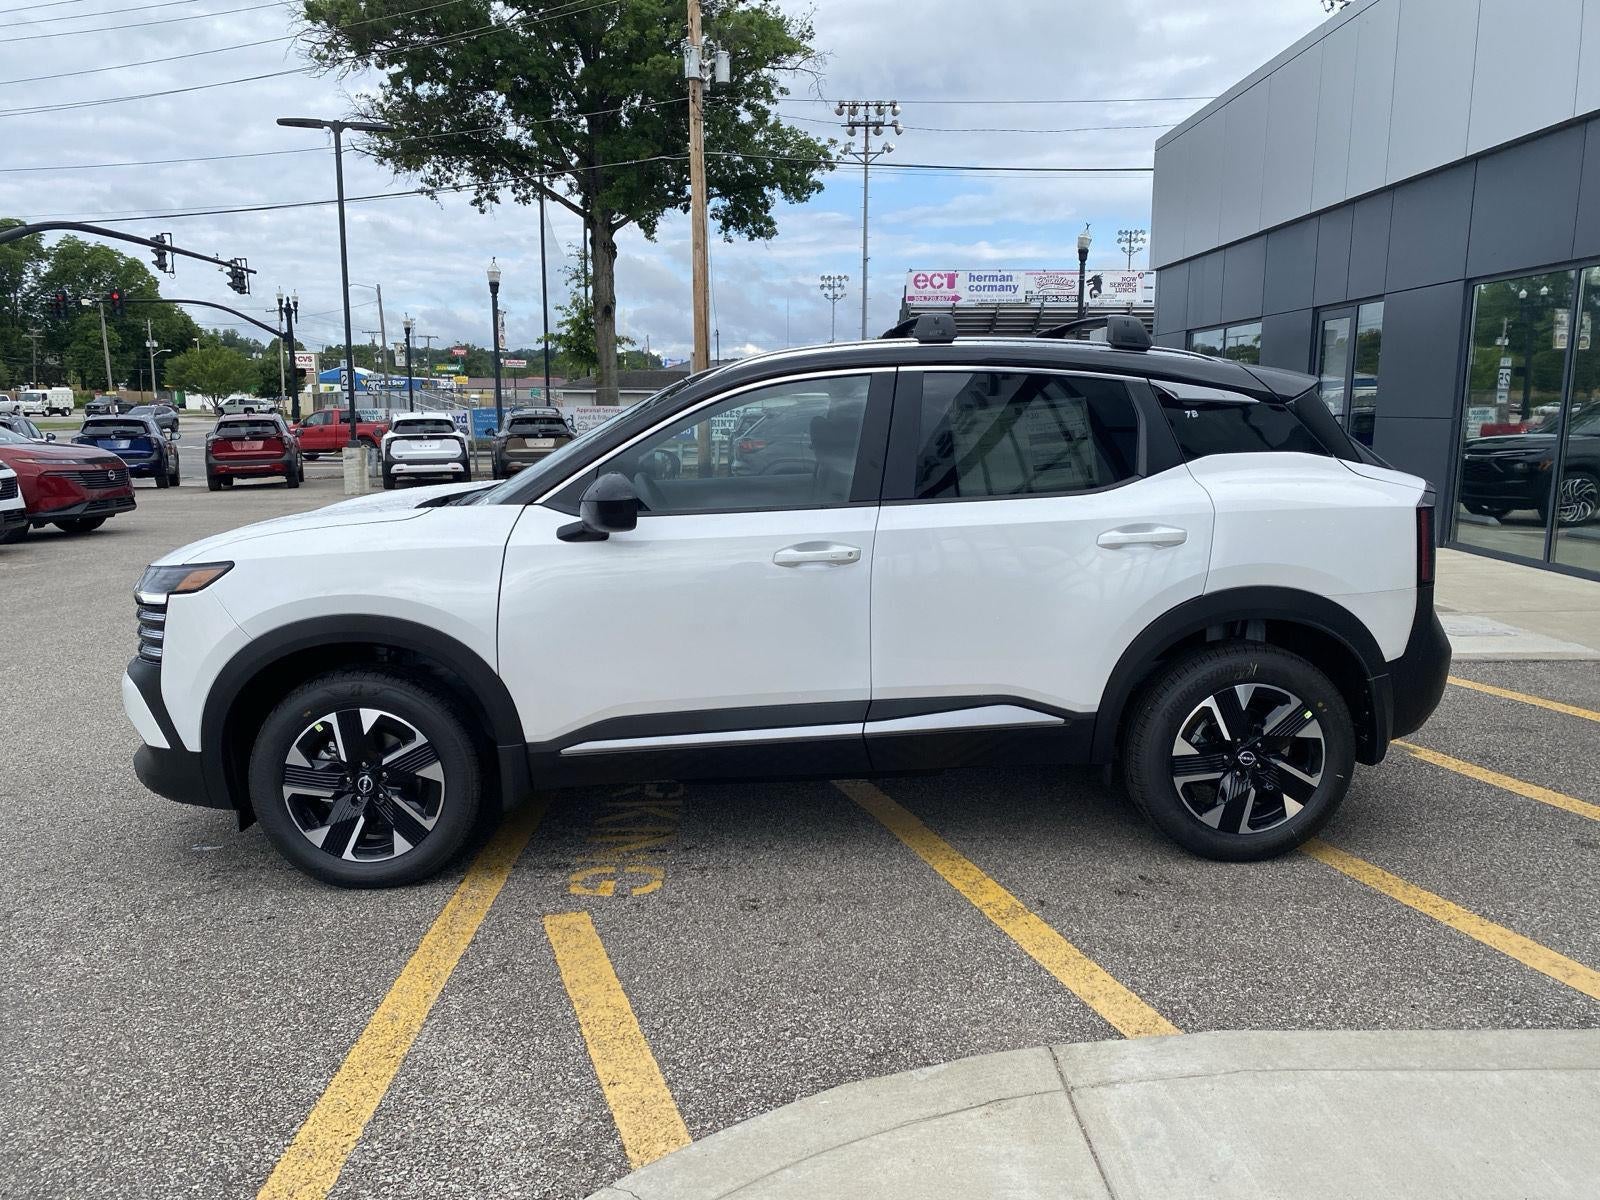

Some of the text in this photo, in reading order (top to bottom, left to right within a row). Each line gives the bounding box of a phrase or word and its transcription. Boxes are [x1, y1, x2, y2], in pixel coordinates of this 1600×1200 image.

[968, 273, 1013, 282] herman
[968, 284, 1019, 294] cormany
[297, 355, 313, 363] CVS
[367, 383, 381, 392] 60
